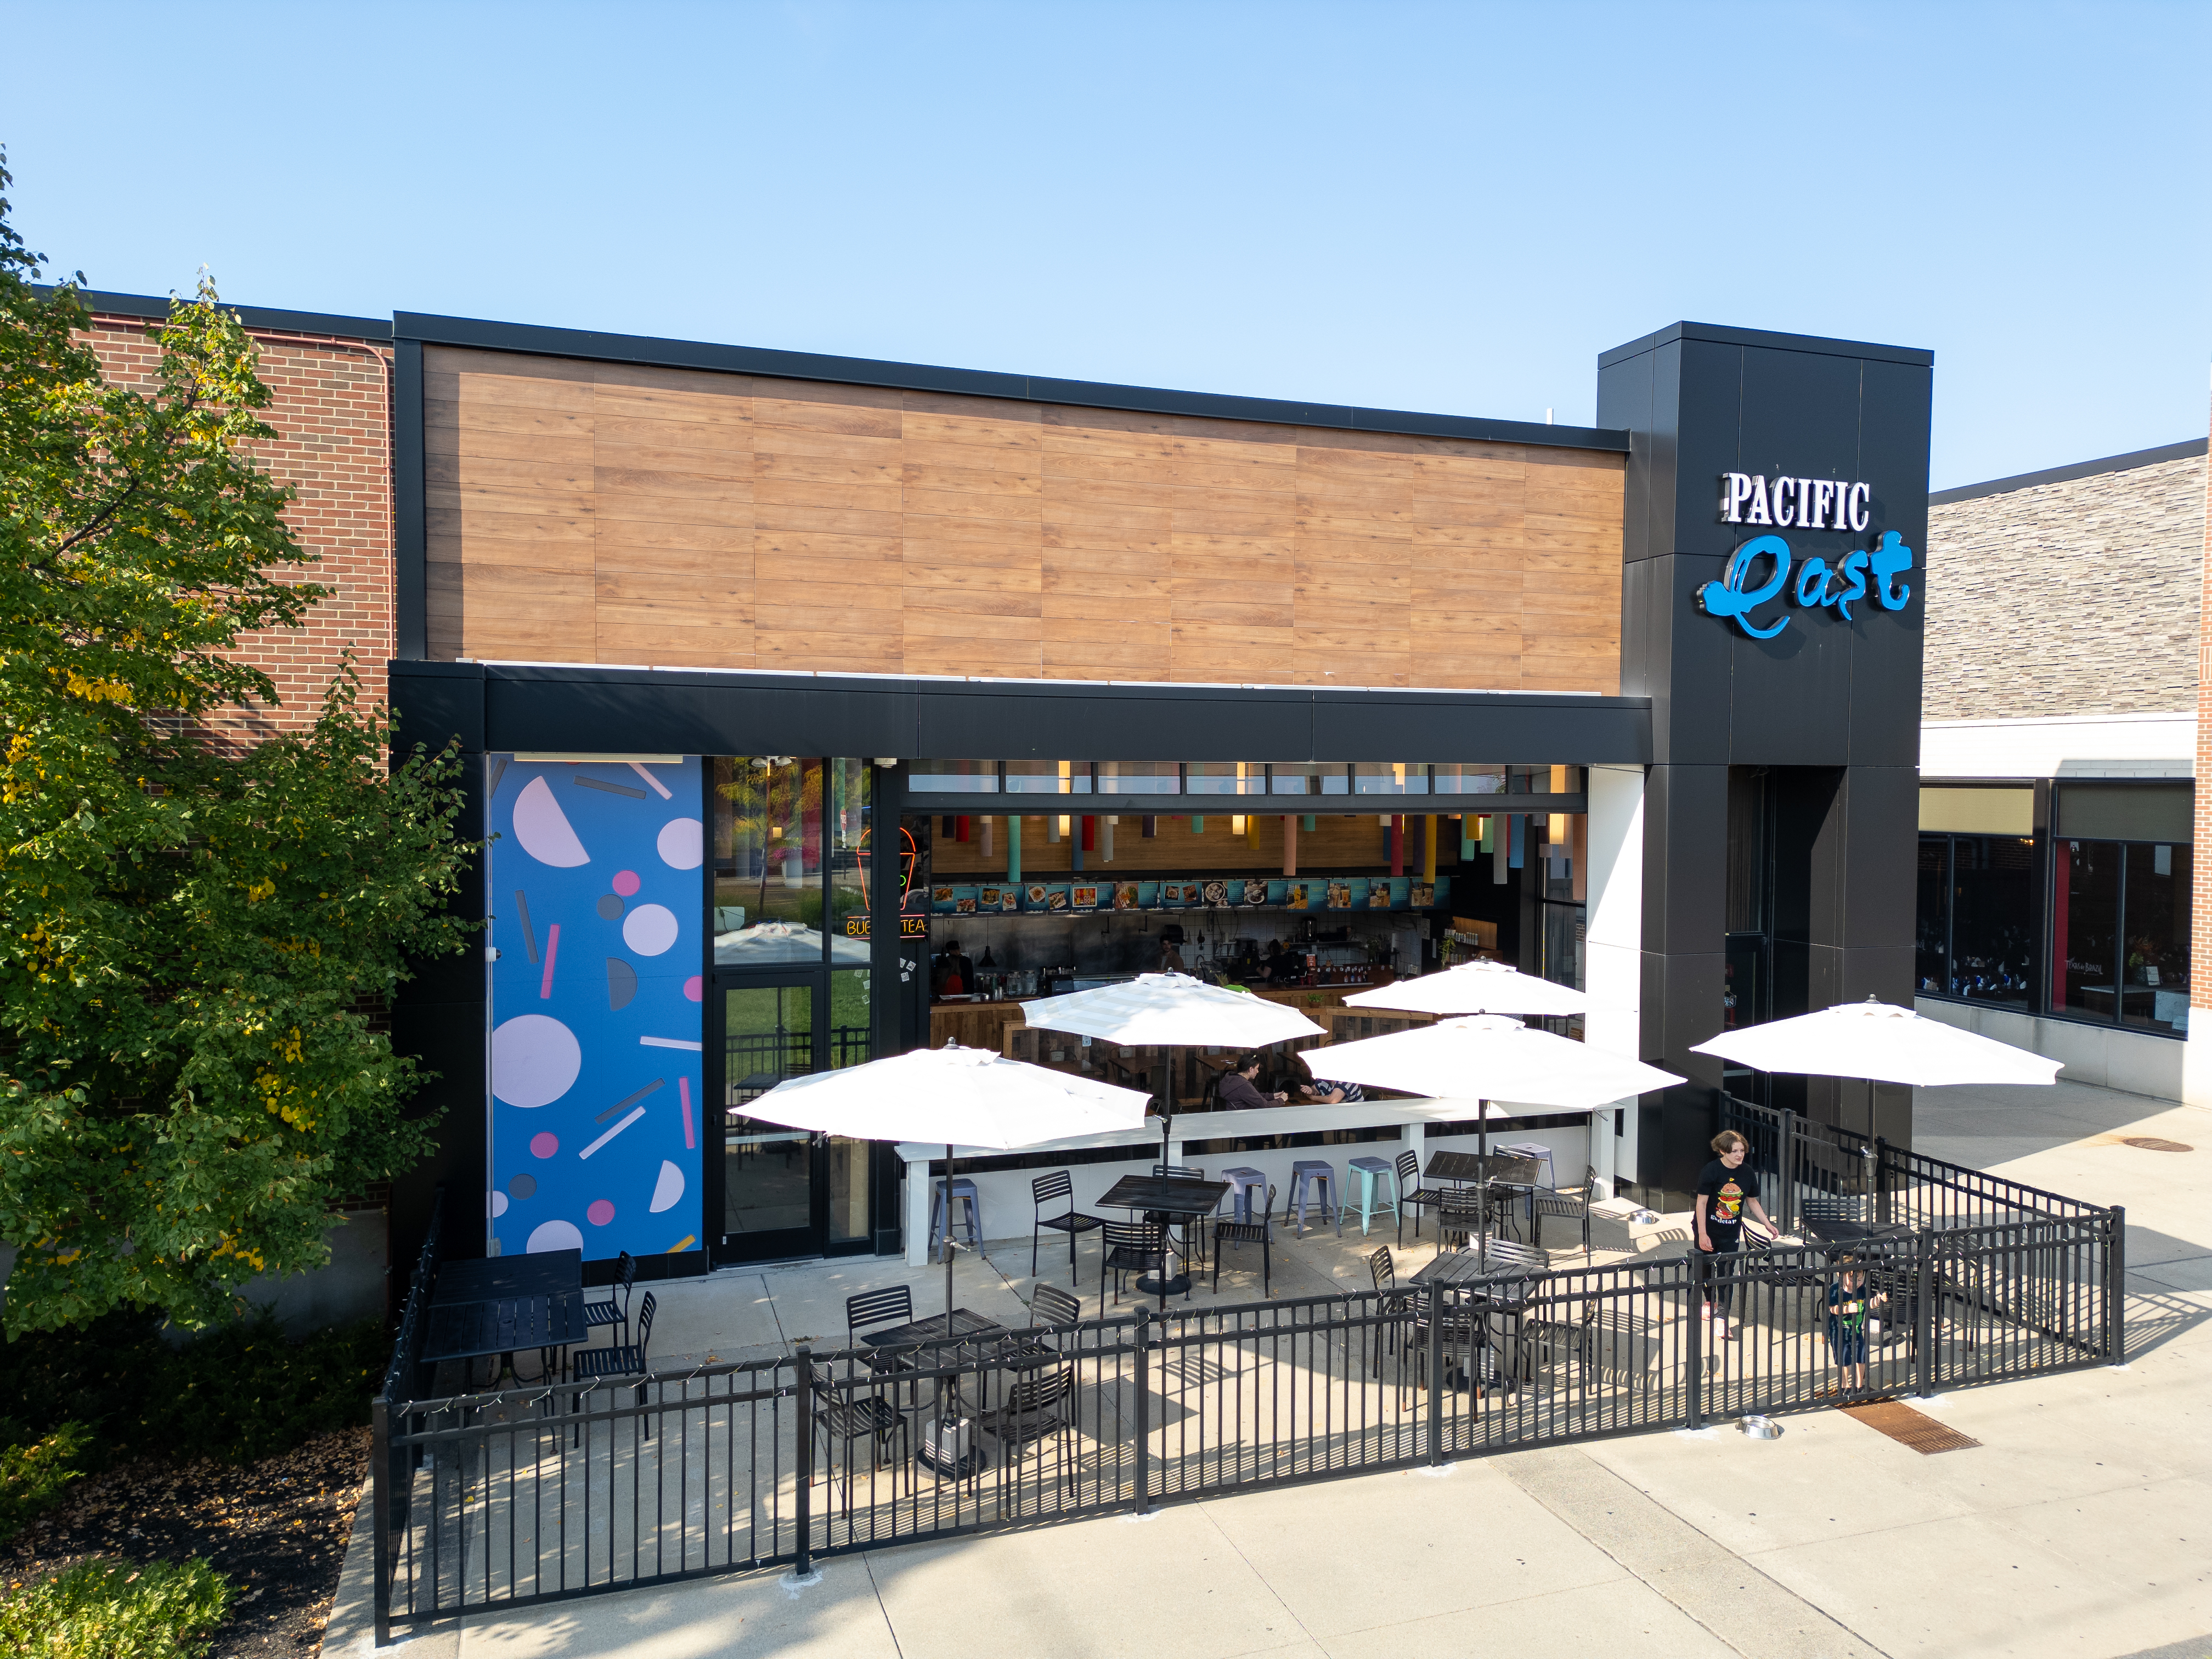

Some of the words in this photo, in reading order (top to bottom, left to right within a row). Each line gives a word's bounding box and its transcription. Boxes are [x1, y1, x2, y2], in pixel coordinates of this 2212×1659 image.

[1722, 472, 1870, 532] PACIFIC
[1697, 530, 1912, 639] East
[901, 919, 925, 933] TEA
